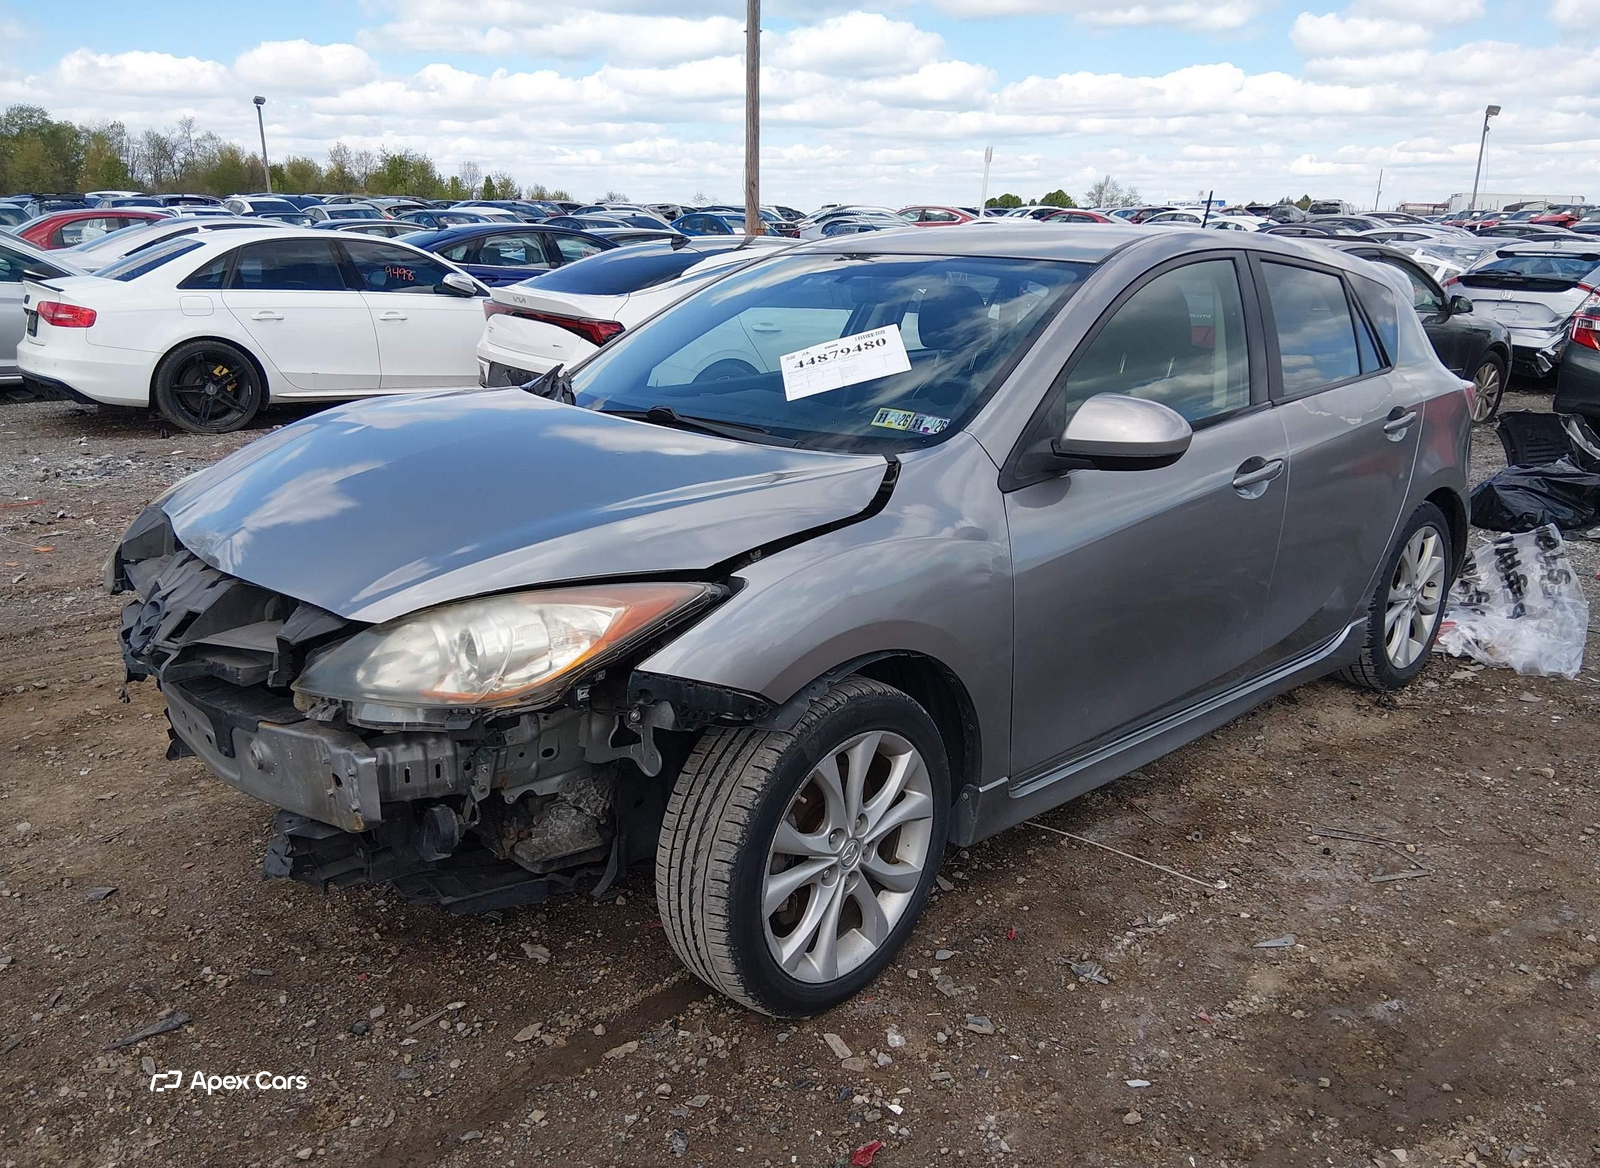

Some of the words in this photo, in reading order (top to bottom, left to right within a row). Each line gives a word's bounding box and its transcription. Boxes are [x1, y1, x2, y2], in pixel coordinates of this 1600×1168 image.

[385, 265, 415, 281] 9498
[793, 337, 887, 369] 44879480
[898, 414, 911, 427] 26
